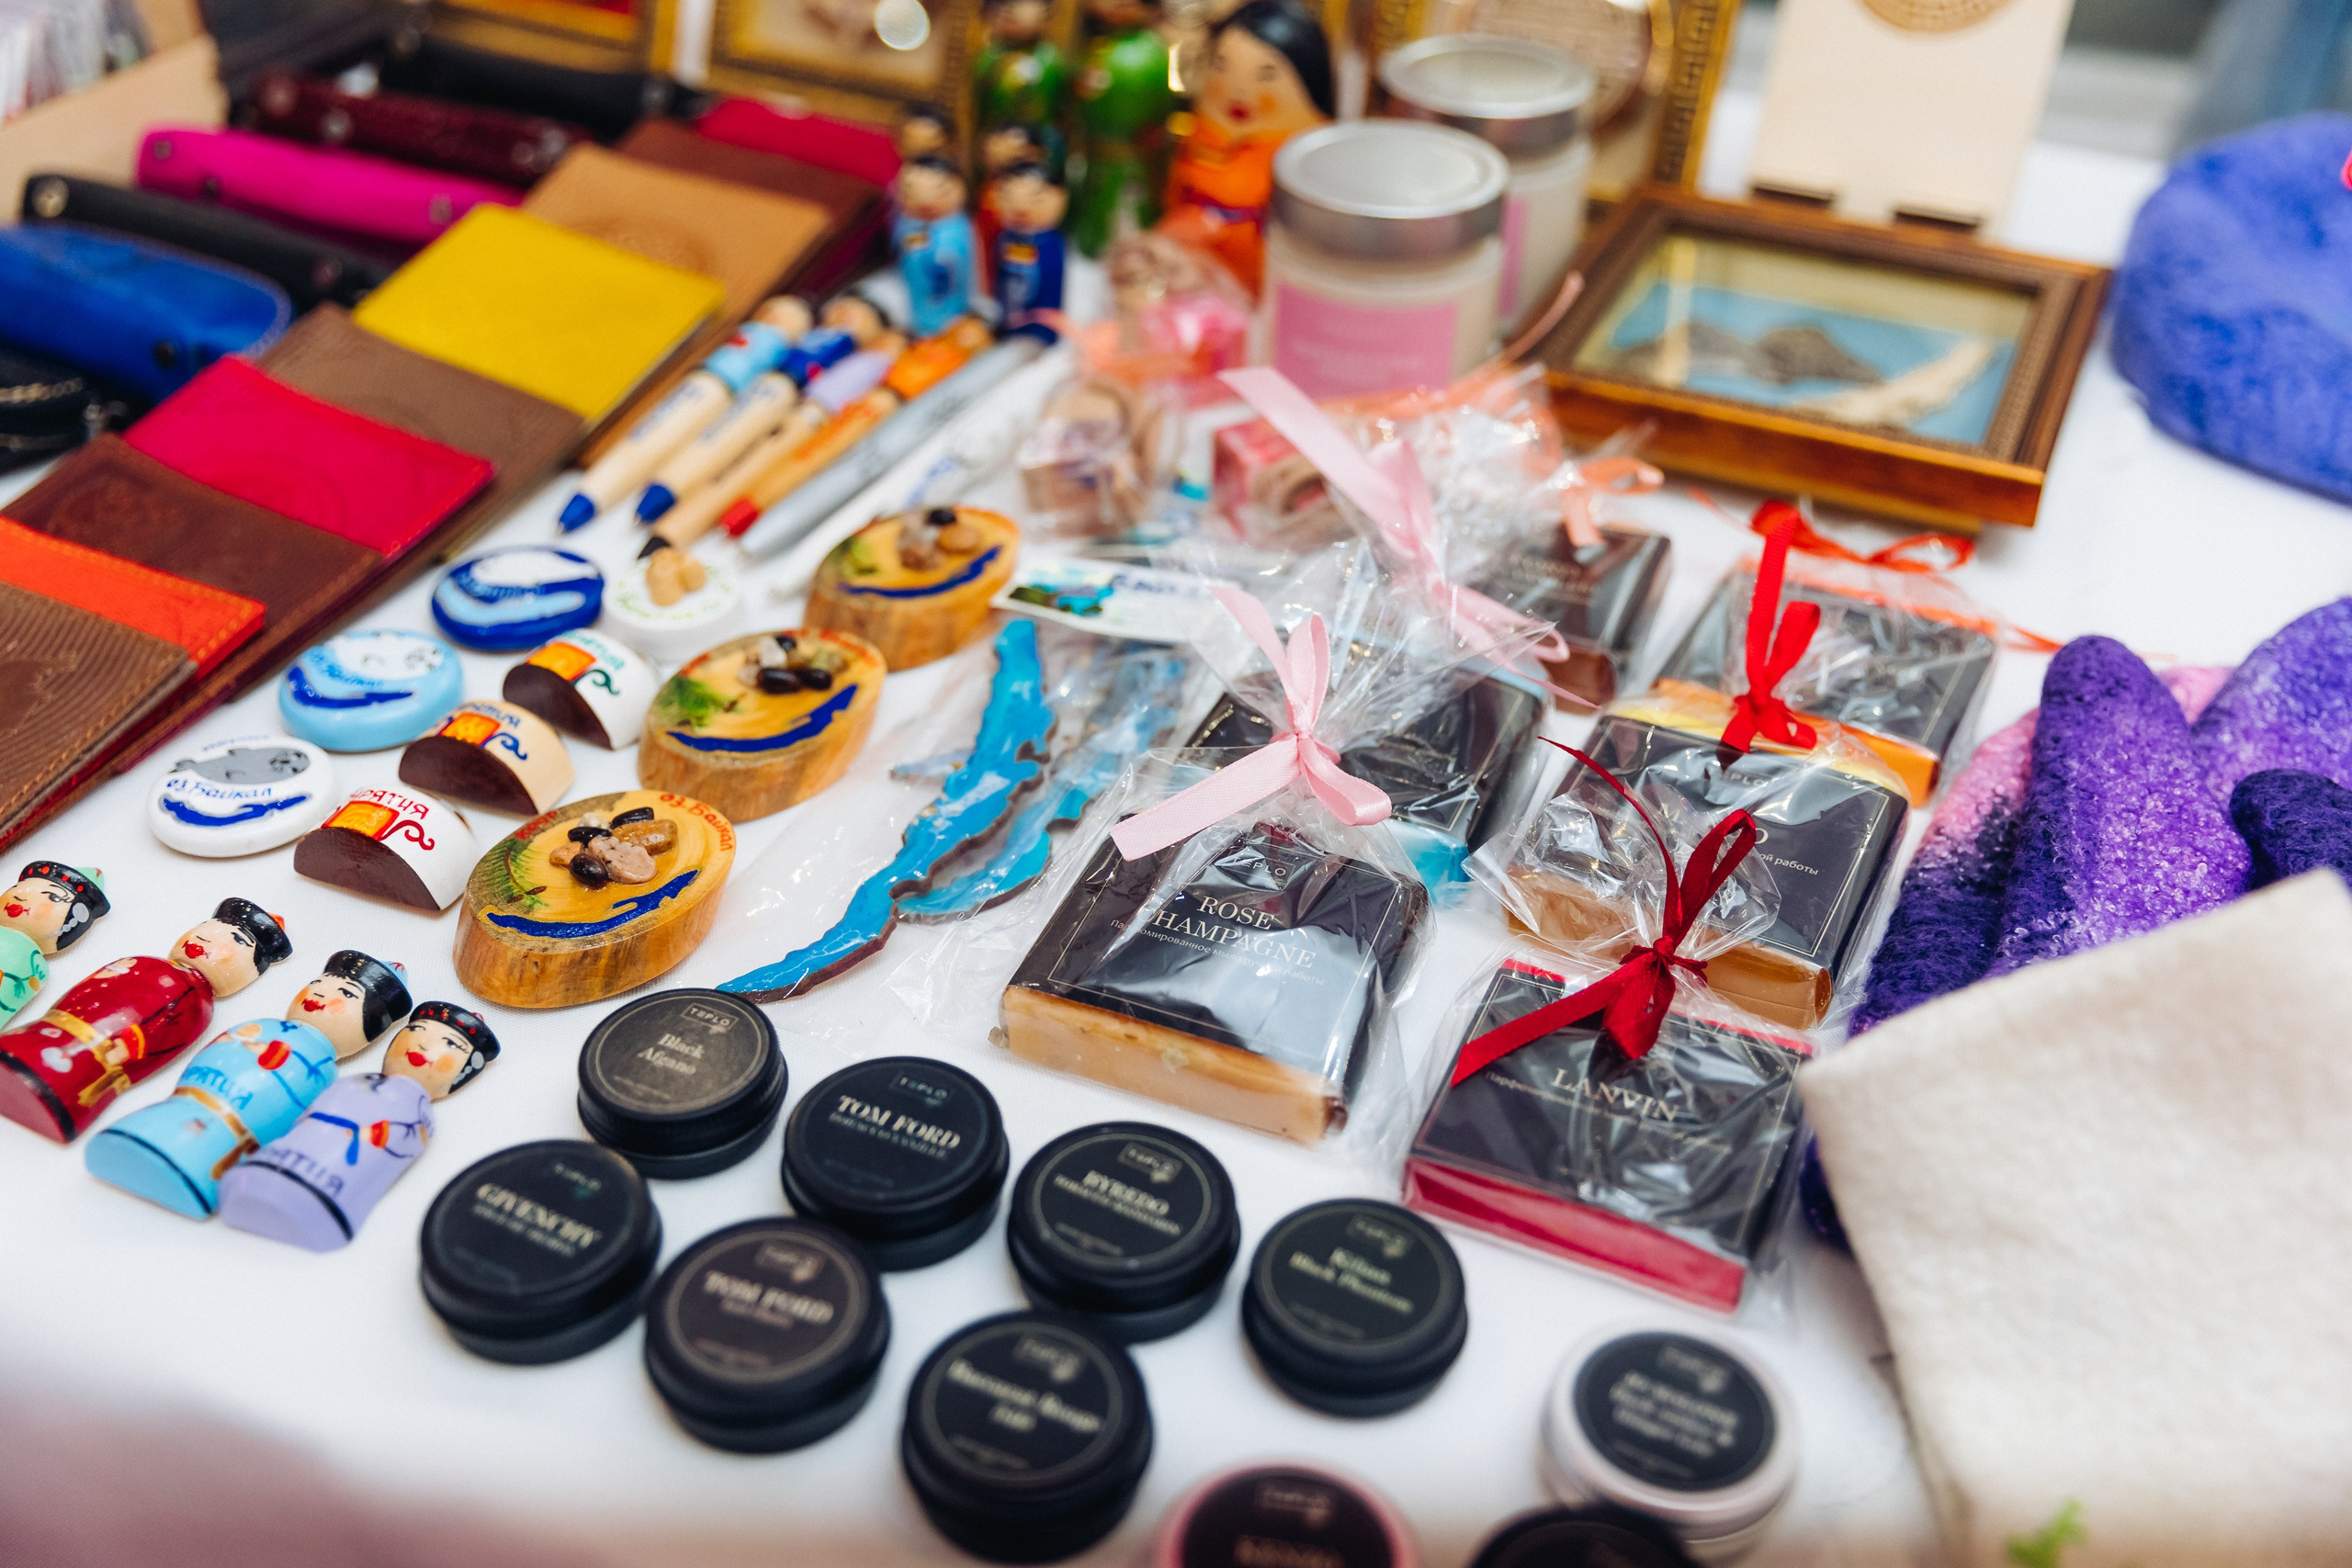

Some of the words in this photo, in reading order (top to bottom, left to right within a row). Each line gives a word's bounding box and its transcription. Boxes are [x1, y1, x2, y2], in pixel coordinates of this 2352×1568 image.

[687, 801, 733, 852] Байкал
[1774, 857, 1819, 875] работы
[1196, 895, 1276, 931] ROSE
[1111, 919, 1211, 953] Пармированное
[690, 1008, 731, 1027] TEPLO
[657, 1033, 705, 1059] Black
[1551, 1067, 1679, 1122] LANVIN
[838, 1094, 892, 1127] TOM
[892, 1114, 961, 1148] FORD
